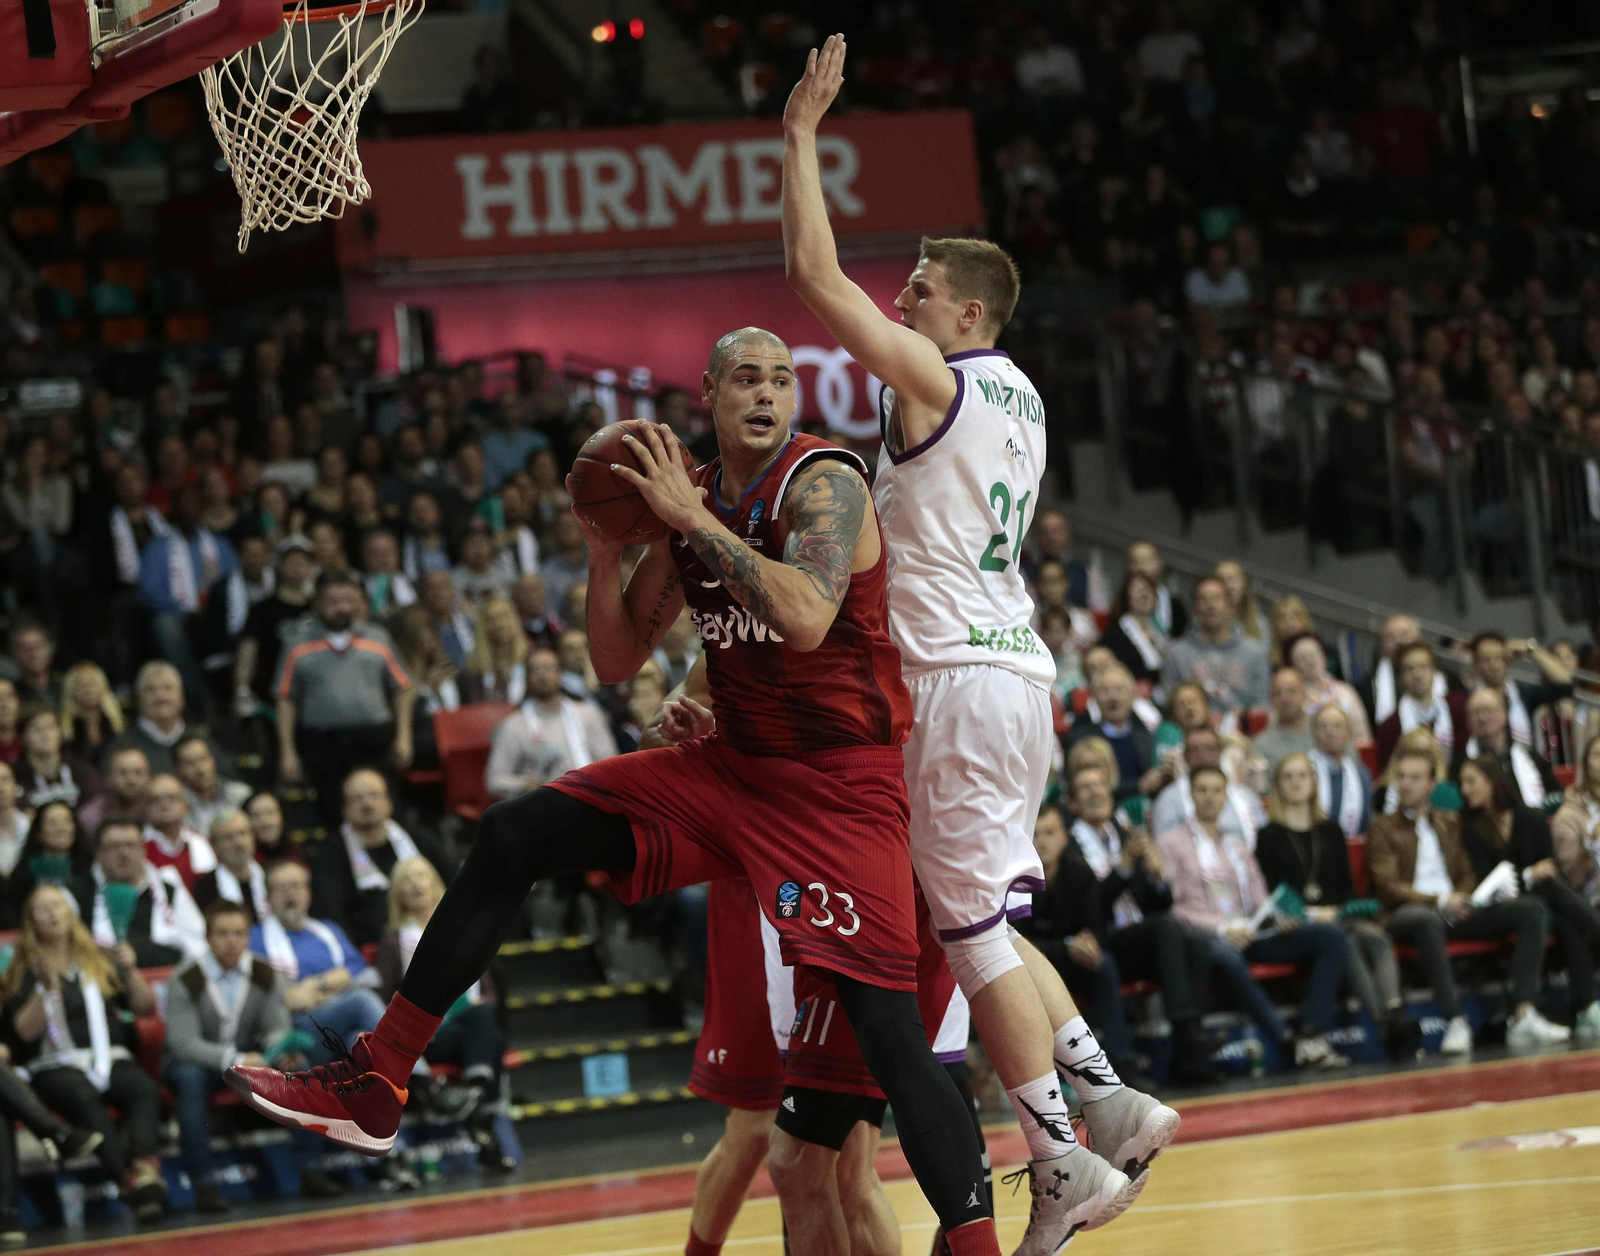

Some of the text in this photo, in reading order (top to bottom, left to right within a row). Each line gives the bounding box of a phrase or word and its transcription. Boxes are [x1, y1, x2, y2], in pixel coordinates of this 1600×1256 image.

[455, 134, 867, 240] HIRMER
[979, 481, 1032, 573] 21
[807, 882, 861, 936] 33
